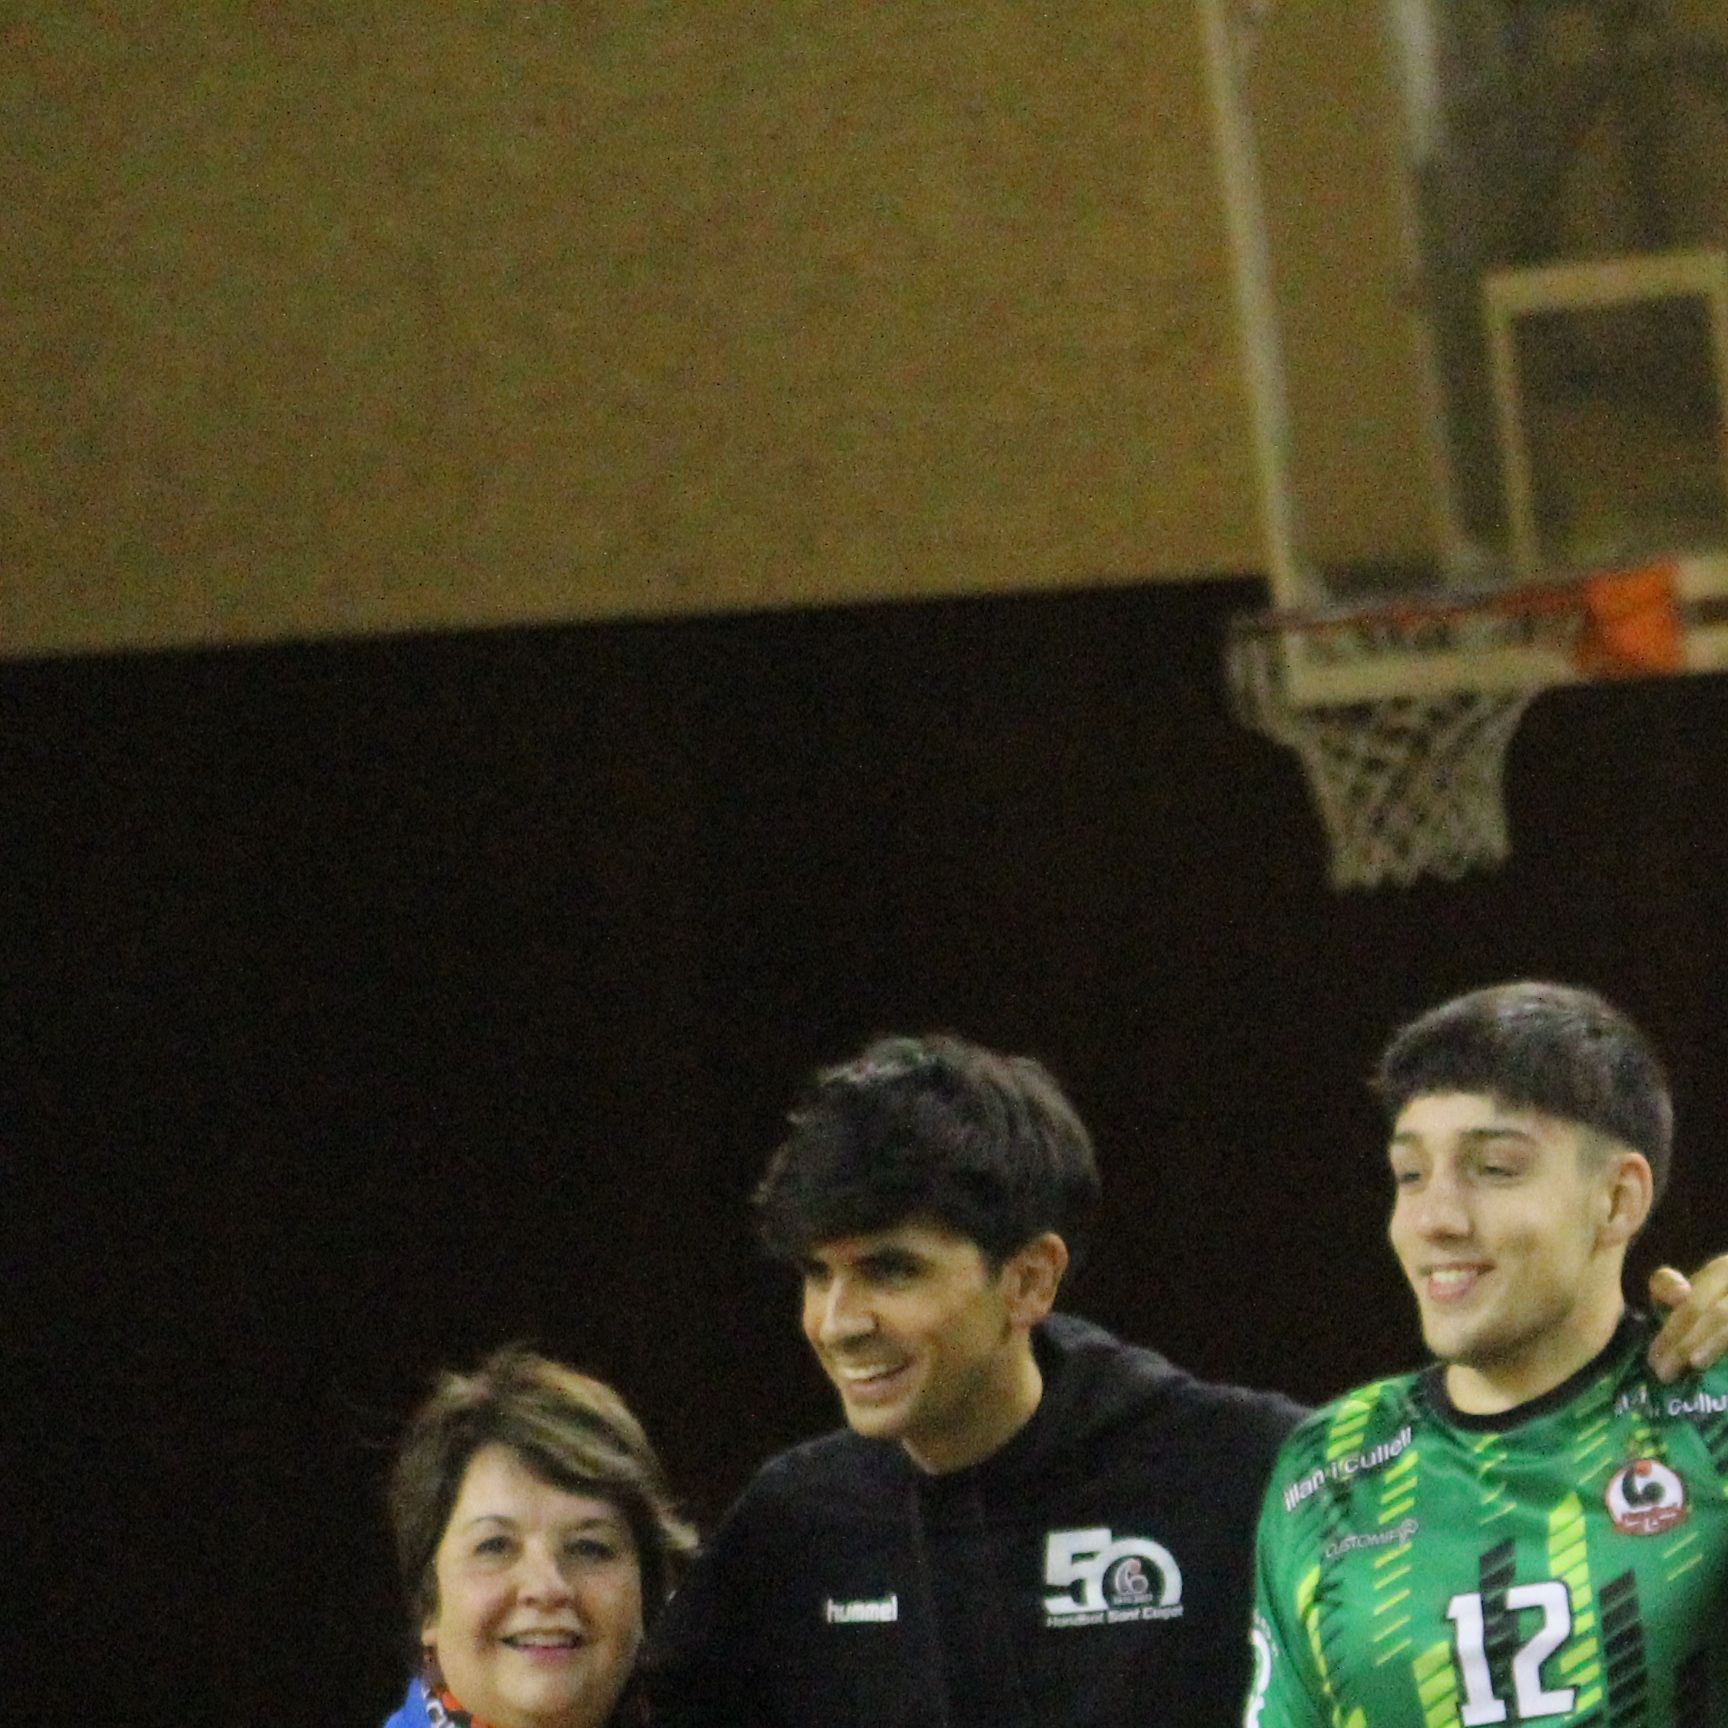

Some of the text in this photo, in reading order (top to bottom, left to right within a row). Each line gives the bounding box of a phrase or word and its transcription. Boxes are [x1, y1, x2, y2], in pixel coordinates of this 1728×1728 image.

[825, 1592, 898, 1624] hummel
[1045, 1526, 1184, 1616] 50
[1445, 1579, 1576, 1728] 12
